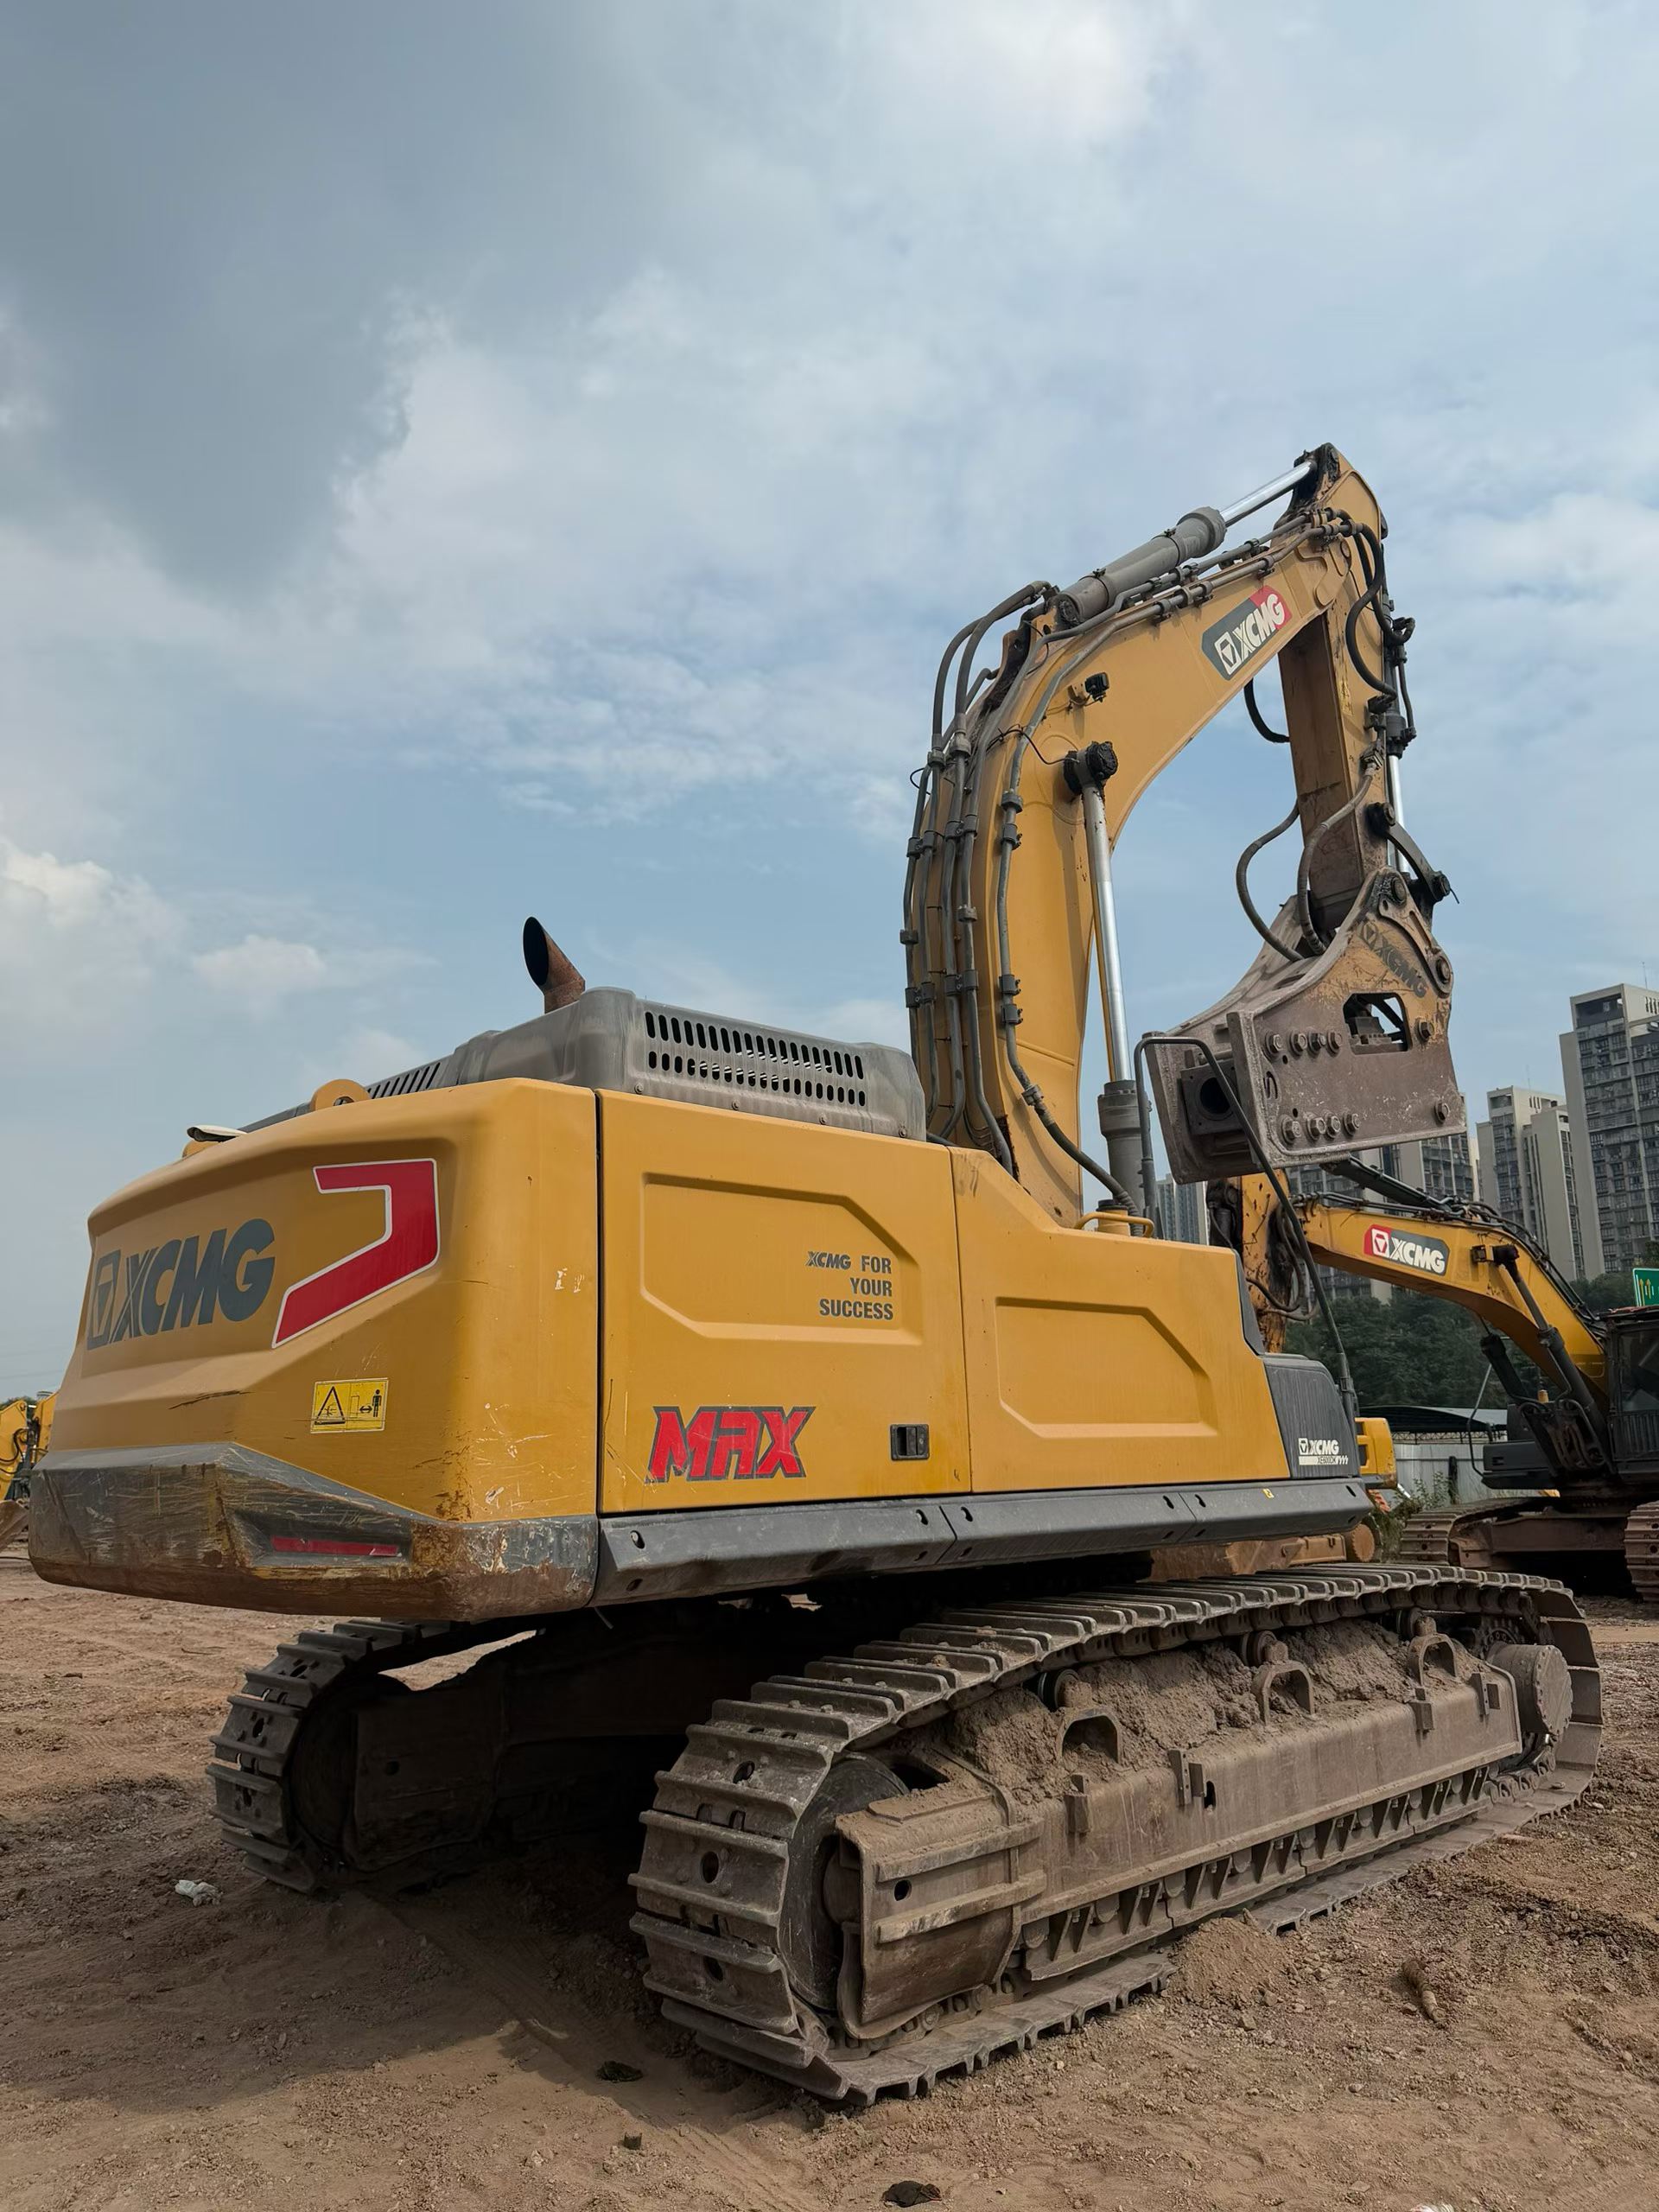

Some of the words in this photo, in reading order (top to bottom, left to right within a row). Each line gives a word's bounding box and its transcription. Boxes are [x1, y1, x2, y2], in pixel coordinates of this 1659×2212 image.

[1232, 593, 1286, 663] XCMG
[805, 1251, 851, 1270] XCMG
[861, 1255, 892, 1274] FOR
[1389, 1236, 1446, 1274] XCMG
[113, 1218, 276, 1344] XCMG
[850, 1277, 893, 1297] YOUR
[819, 1298, 893, 1320] SUCCESS
[644, 1406, 816, 1484] MAX
[1308, 1440, 1339, 1455] XCMG
